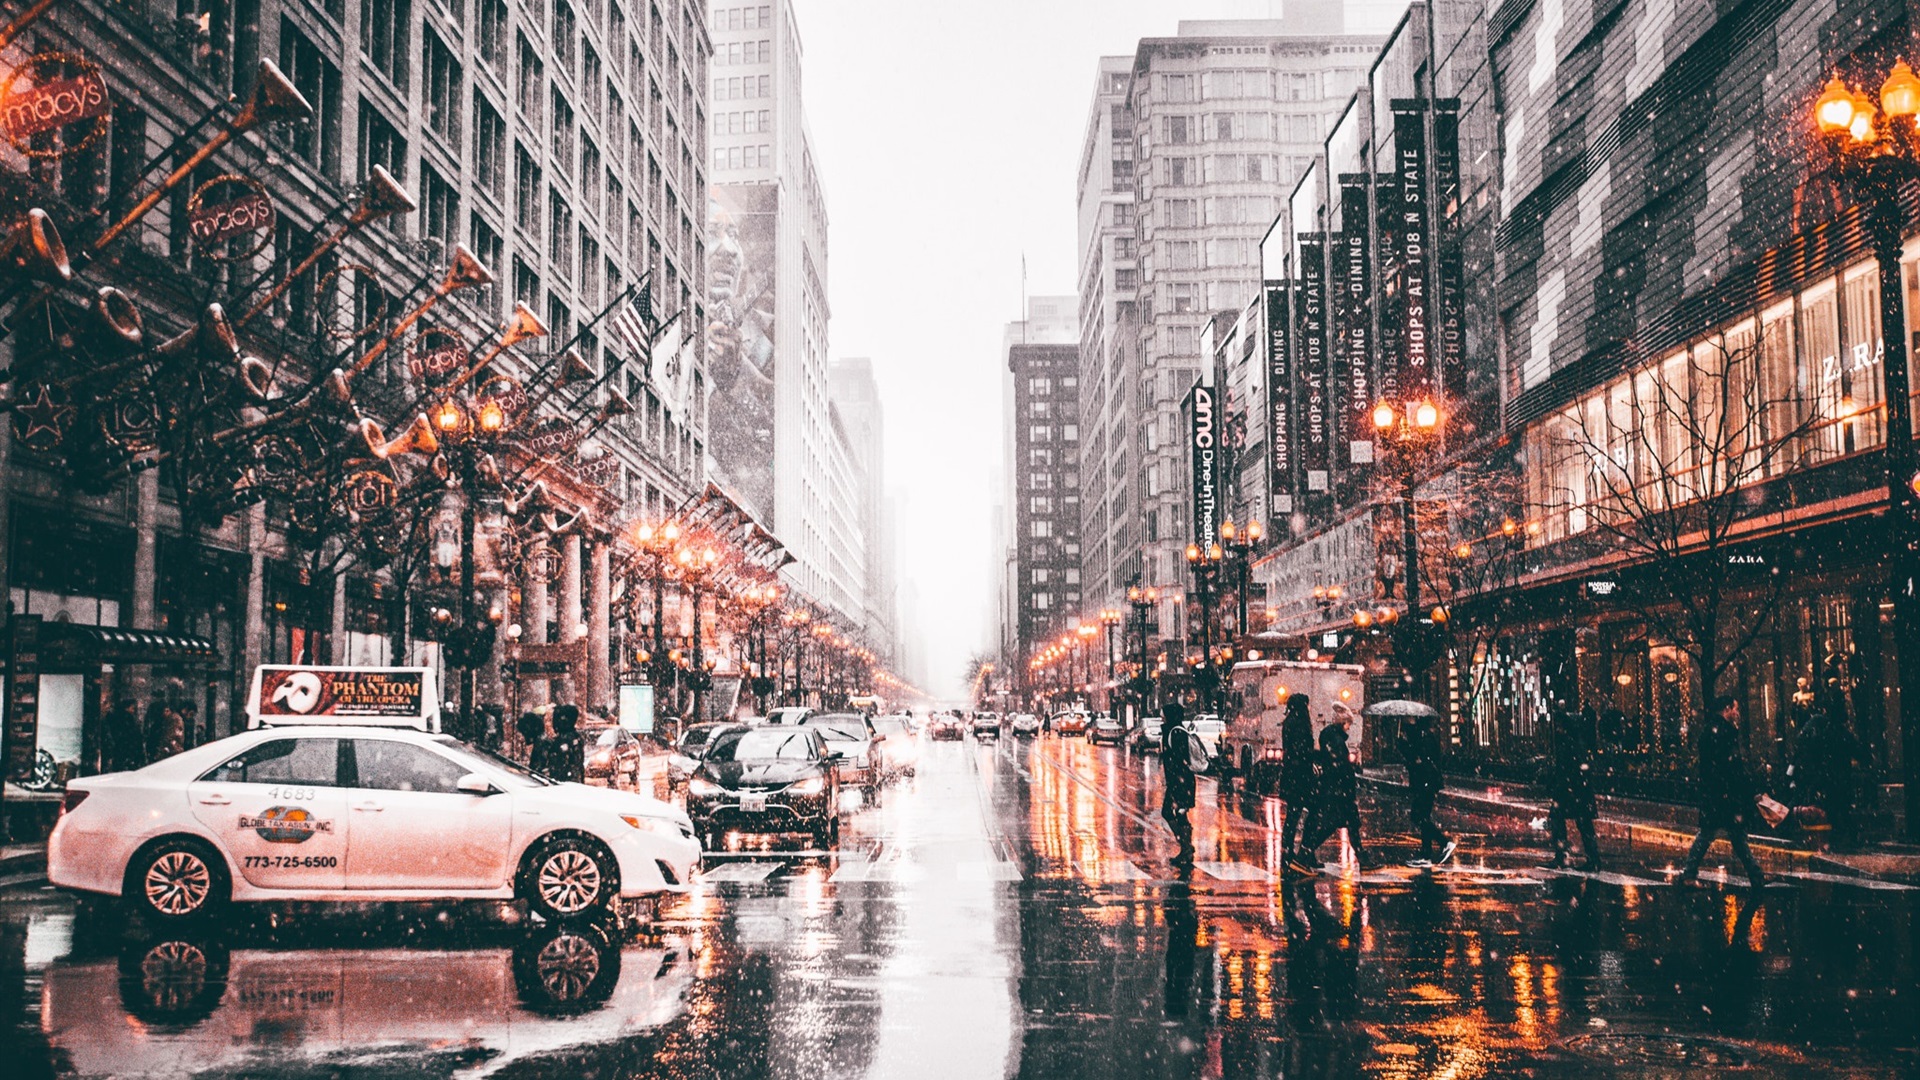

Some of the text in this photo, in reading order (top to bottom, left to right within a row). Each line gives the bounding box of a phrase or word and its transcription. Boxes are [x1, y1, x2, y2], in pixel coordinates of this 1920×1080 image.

[1404, 149, 1424, 366] SHOPS AT 108 N STATE
[1350, 237, 1367, 410] SHOPPING + DINING
[1274, 329, 1285, 375] DINING
[1307, 271, 1322, 443] SHOPS AT 108 N STATE
[1276, 403, 1287, 470] SHOPPING
[1728, 555, 1764, 564] ZARA
[333, 682, 419, 696] PHANTOM
[339, 695, 411, 704] OF THE OPERA
[268, 787, 315, 800] 4683
[240, 817, 266, 828] GLOBE
[245, 856, 337, 868] 773-725-6500
